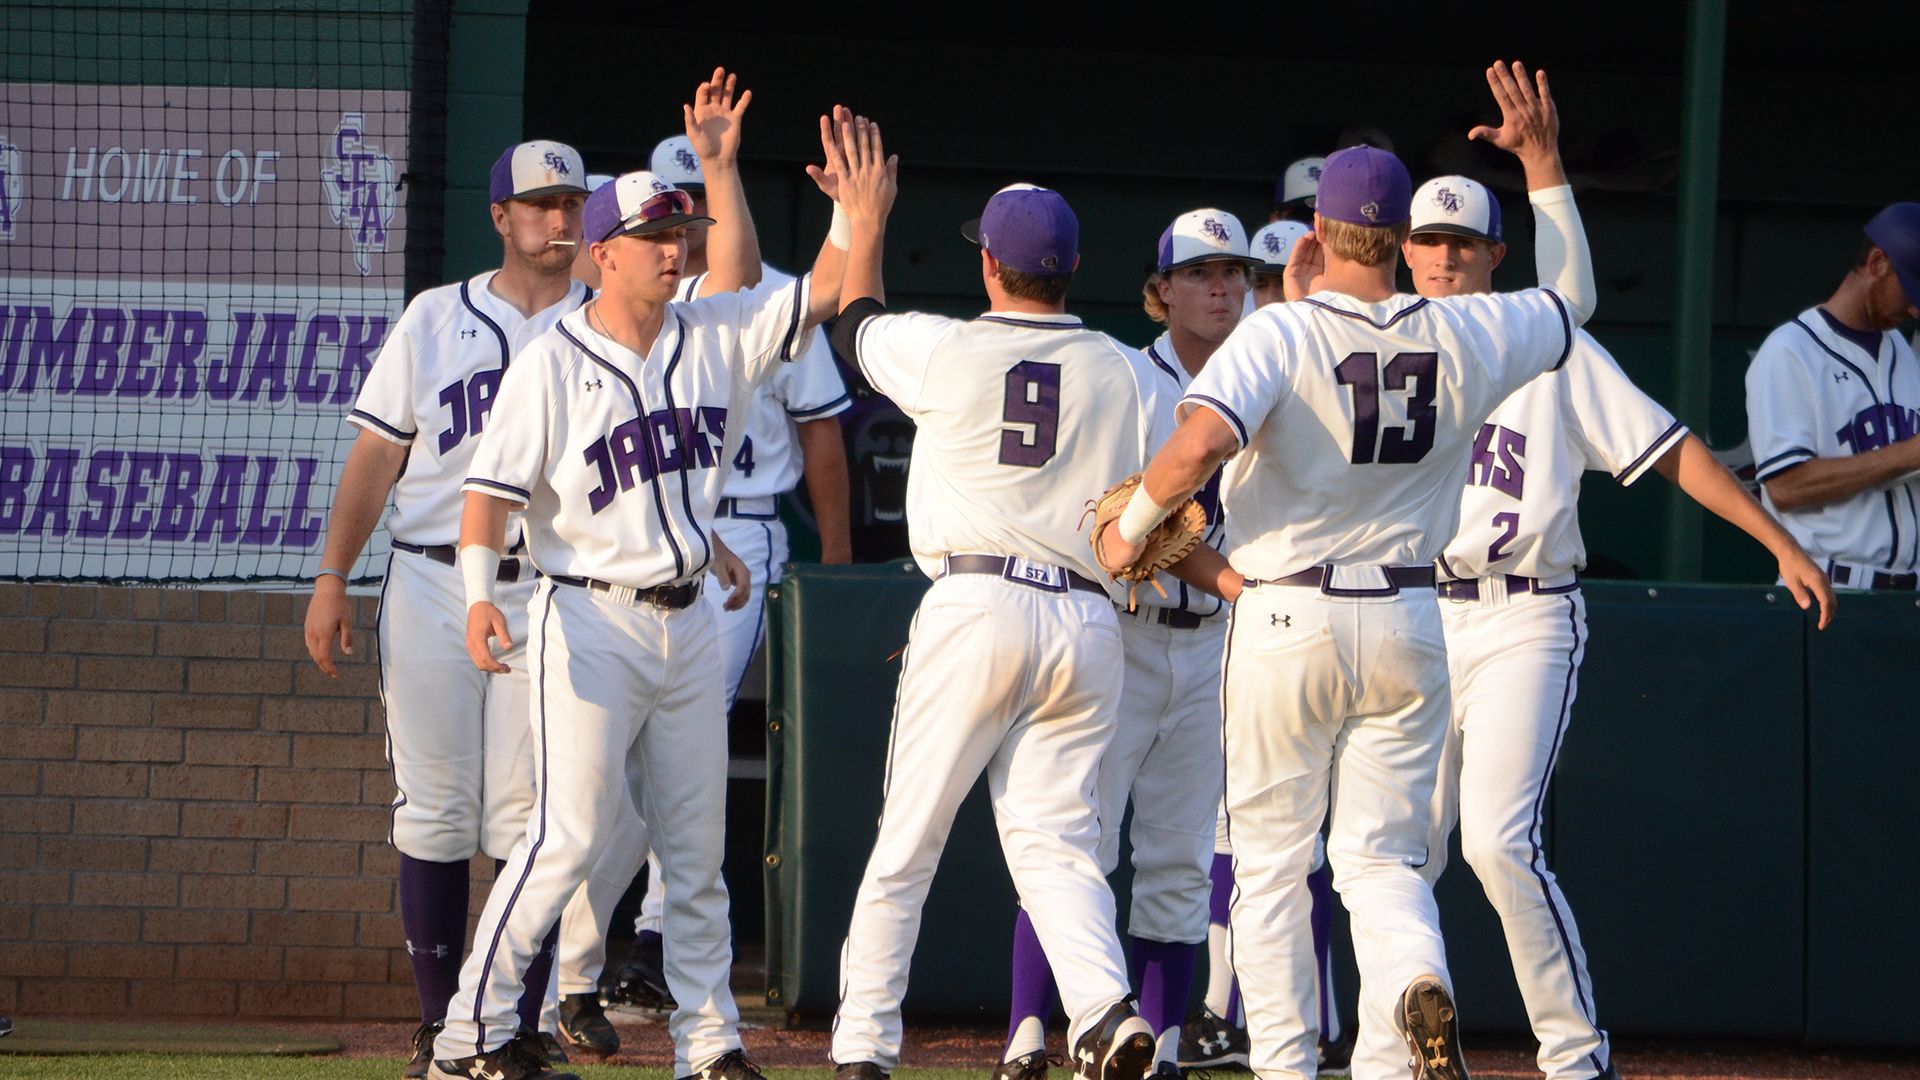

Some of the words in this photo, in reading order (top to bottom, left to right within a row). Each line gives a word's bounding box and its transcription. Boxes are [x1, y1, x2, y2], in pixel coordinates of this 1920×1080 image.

[61, 146, 203, 203] HOME
[215, 149, 281, 207] OF
[998, 360, 1061, 468] 9
[1334, 352, 1438, 464] 13
[733, 434, 755, 478] 4
[0, 446, 323, 547] BASEBALL
[1488, 512, 1520, 563] 2
[1026, 567, 1049, 583] SFA
